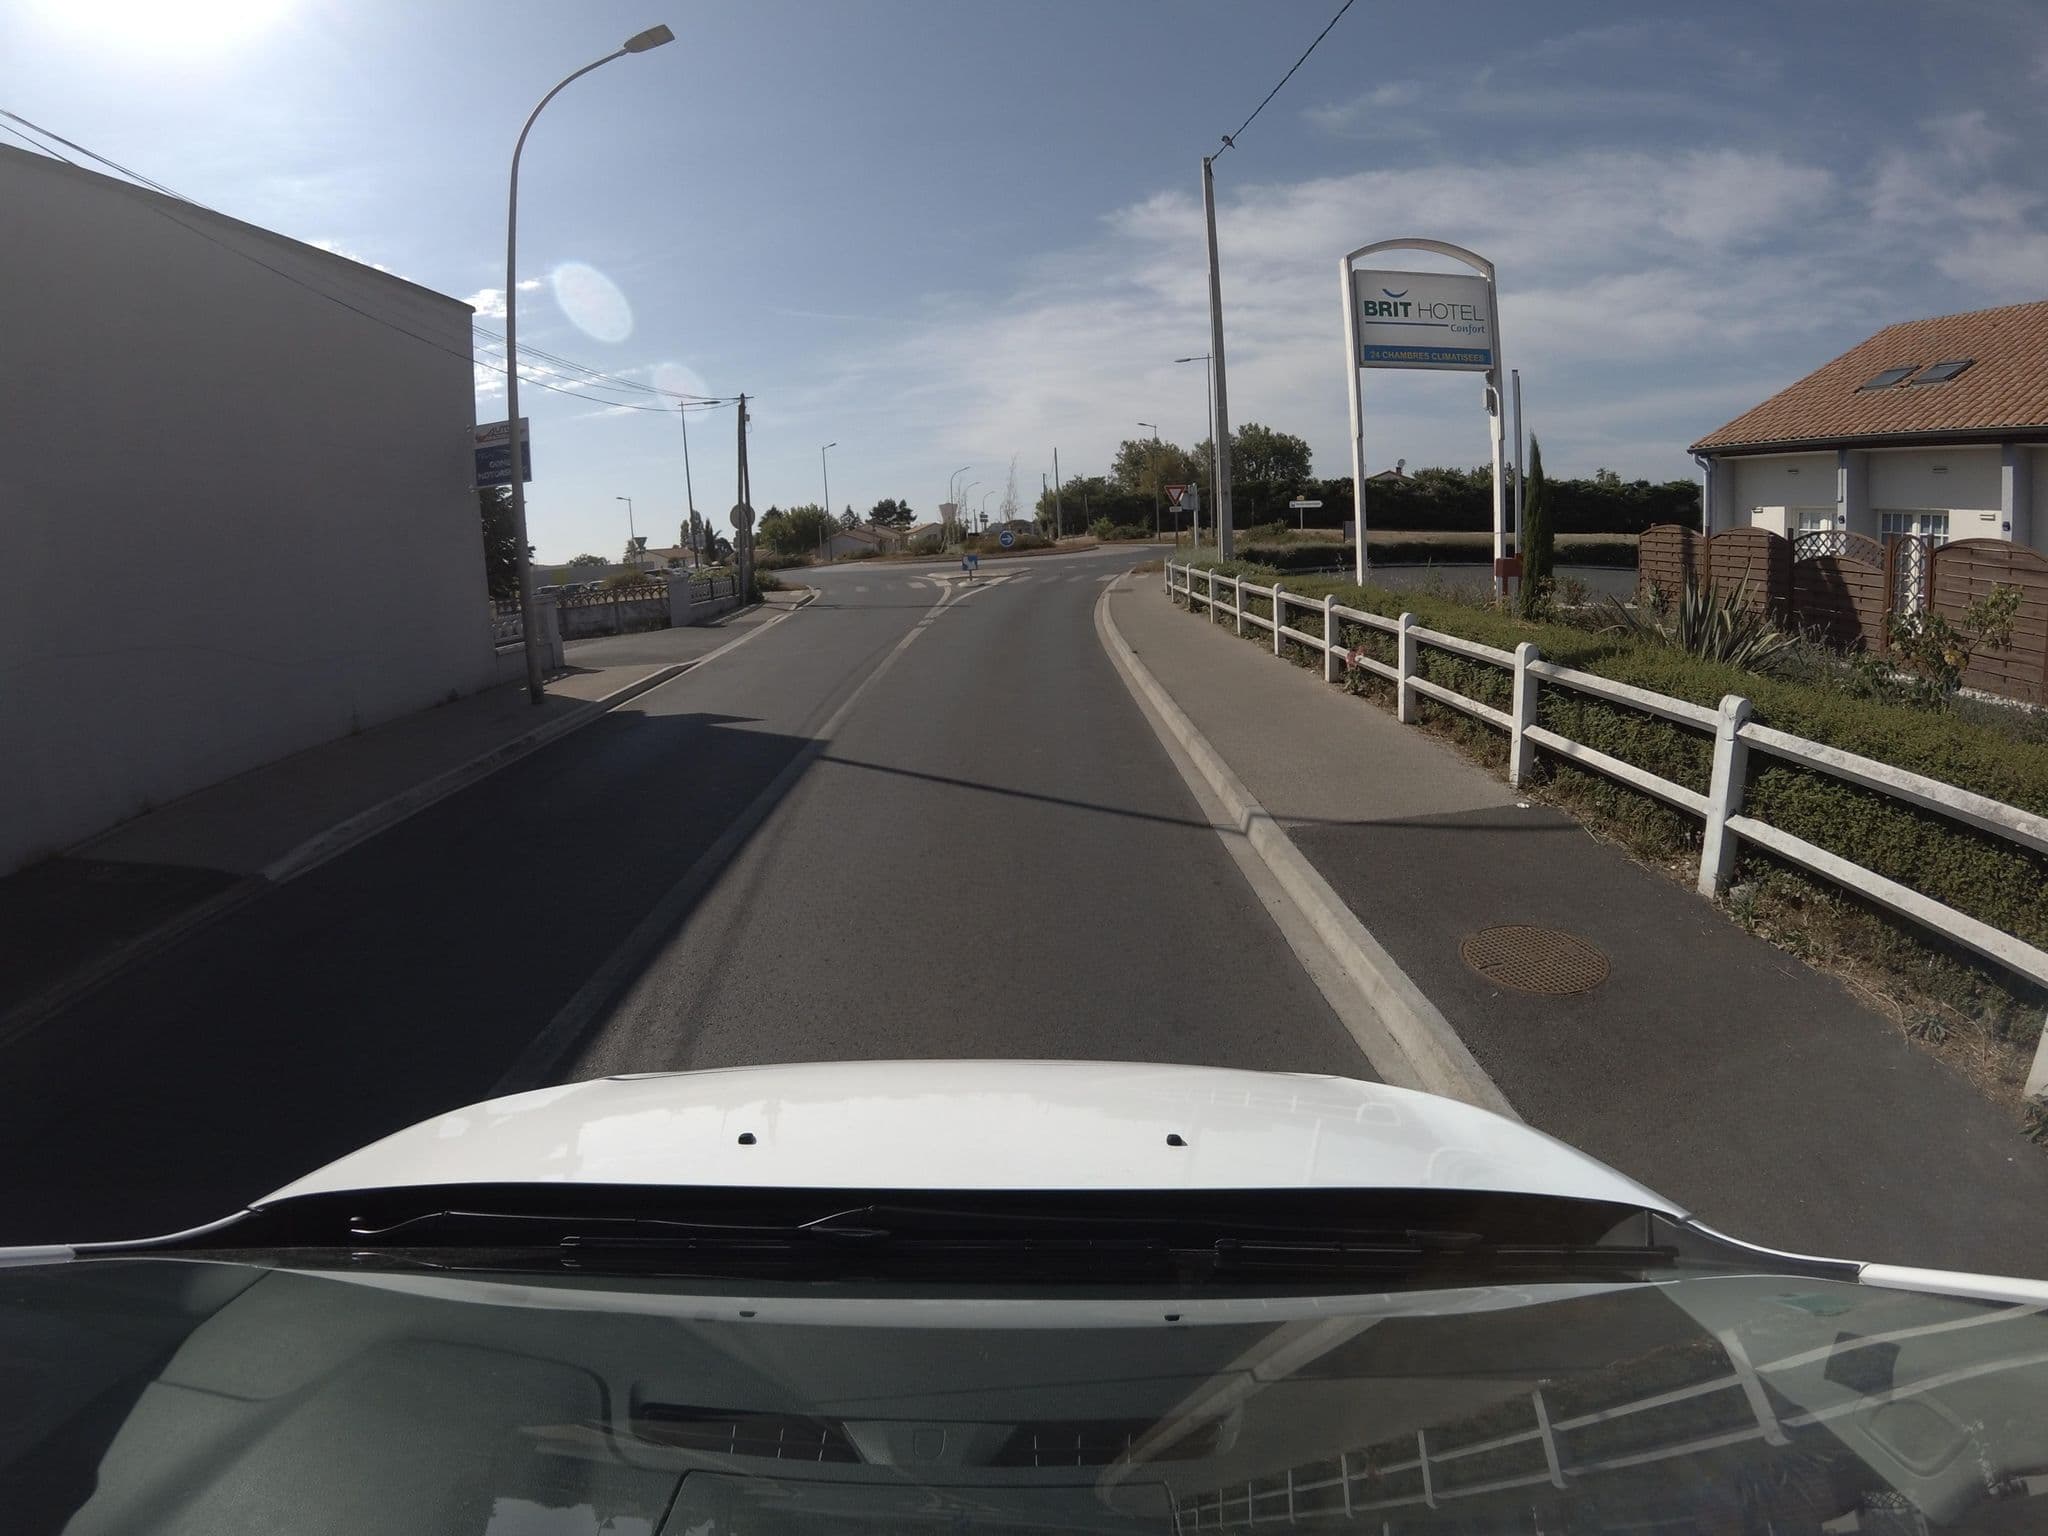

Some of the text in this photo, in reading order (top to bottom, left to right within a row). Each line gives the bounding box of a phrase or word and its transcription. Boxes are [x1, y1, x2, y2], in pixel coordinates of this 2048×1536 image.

[1364, 300, 1485, 321] BRIT HOTEL
[1450, 323, 1485, 335] Confort
[1382, 351, 1430, 360] CHAMBRES
